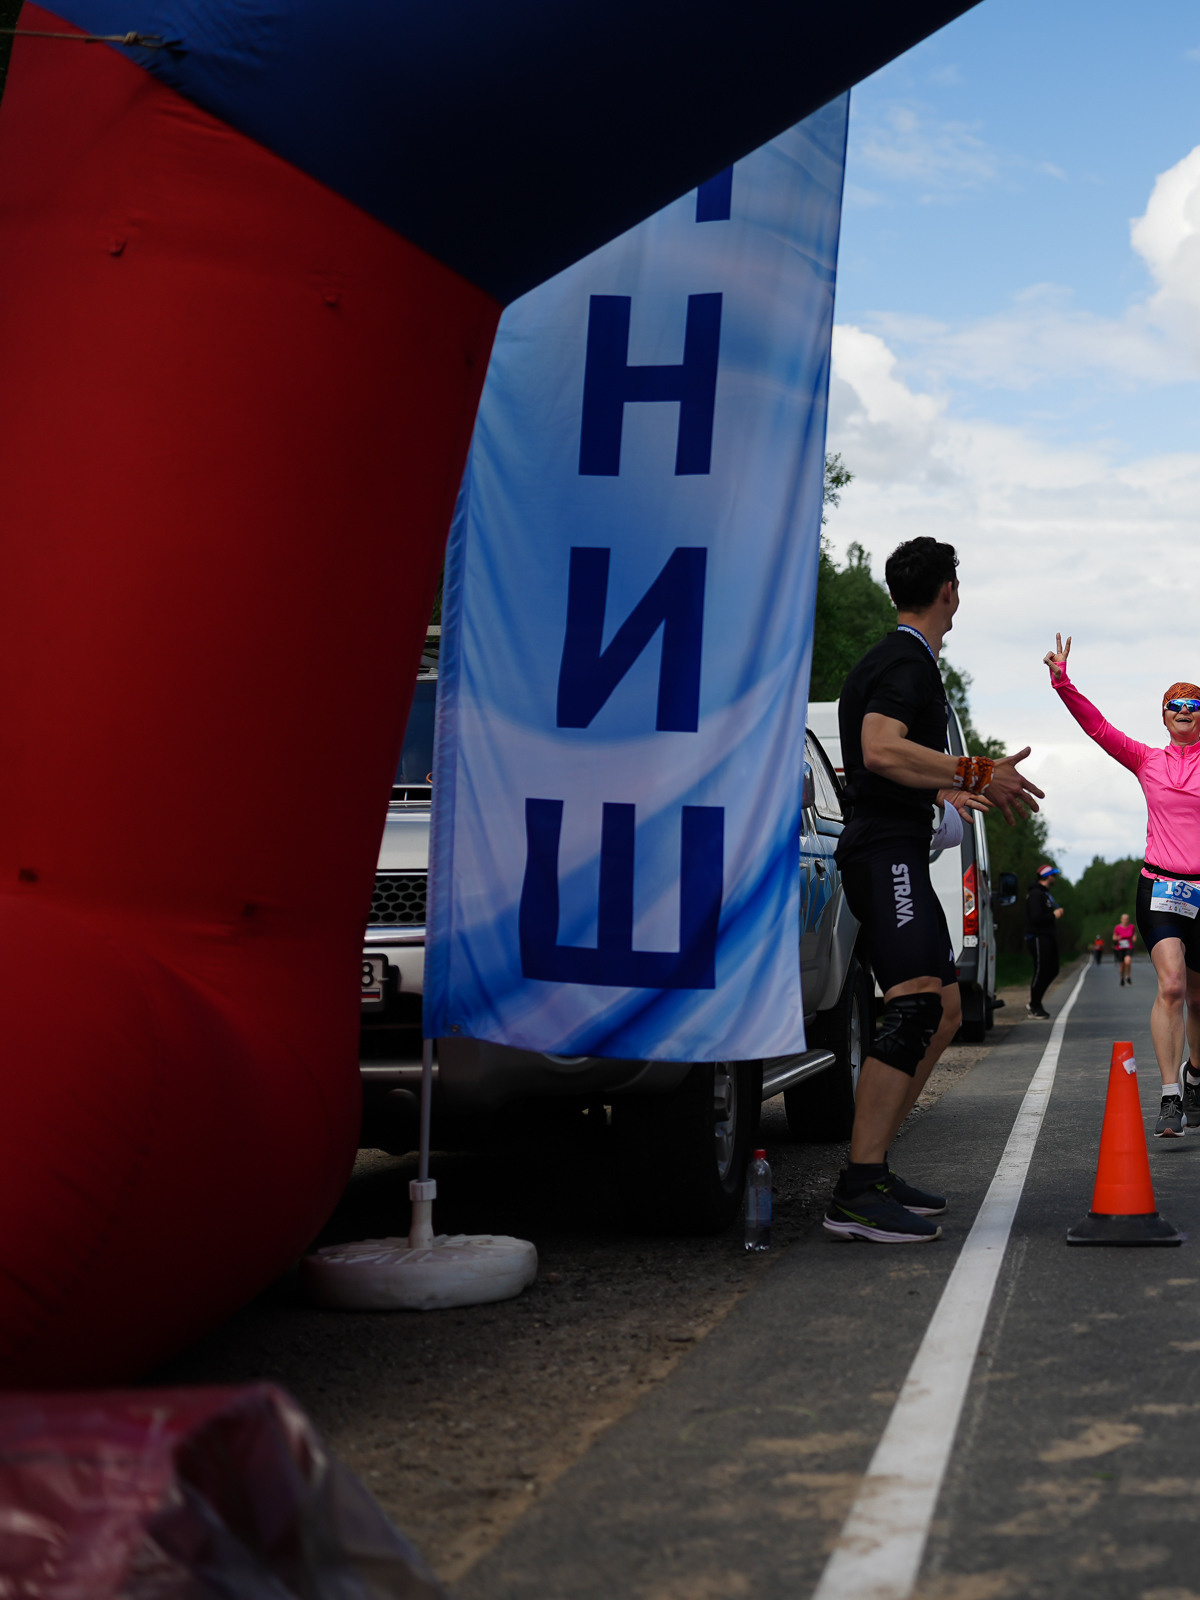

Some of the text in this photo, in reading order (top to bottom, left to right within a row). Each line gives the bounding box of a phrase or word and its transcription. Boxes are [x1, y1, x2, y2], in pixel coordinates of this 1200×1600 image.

[519, 164, 733, 989] НИШ
[891, 863, 914, 928] STRAVA
[1165, 881, 1194, 899] 155
